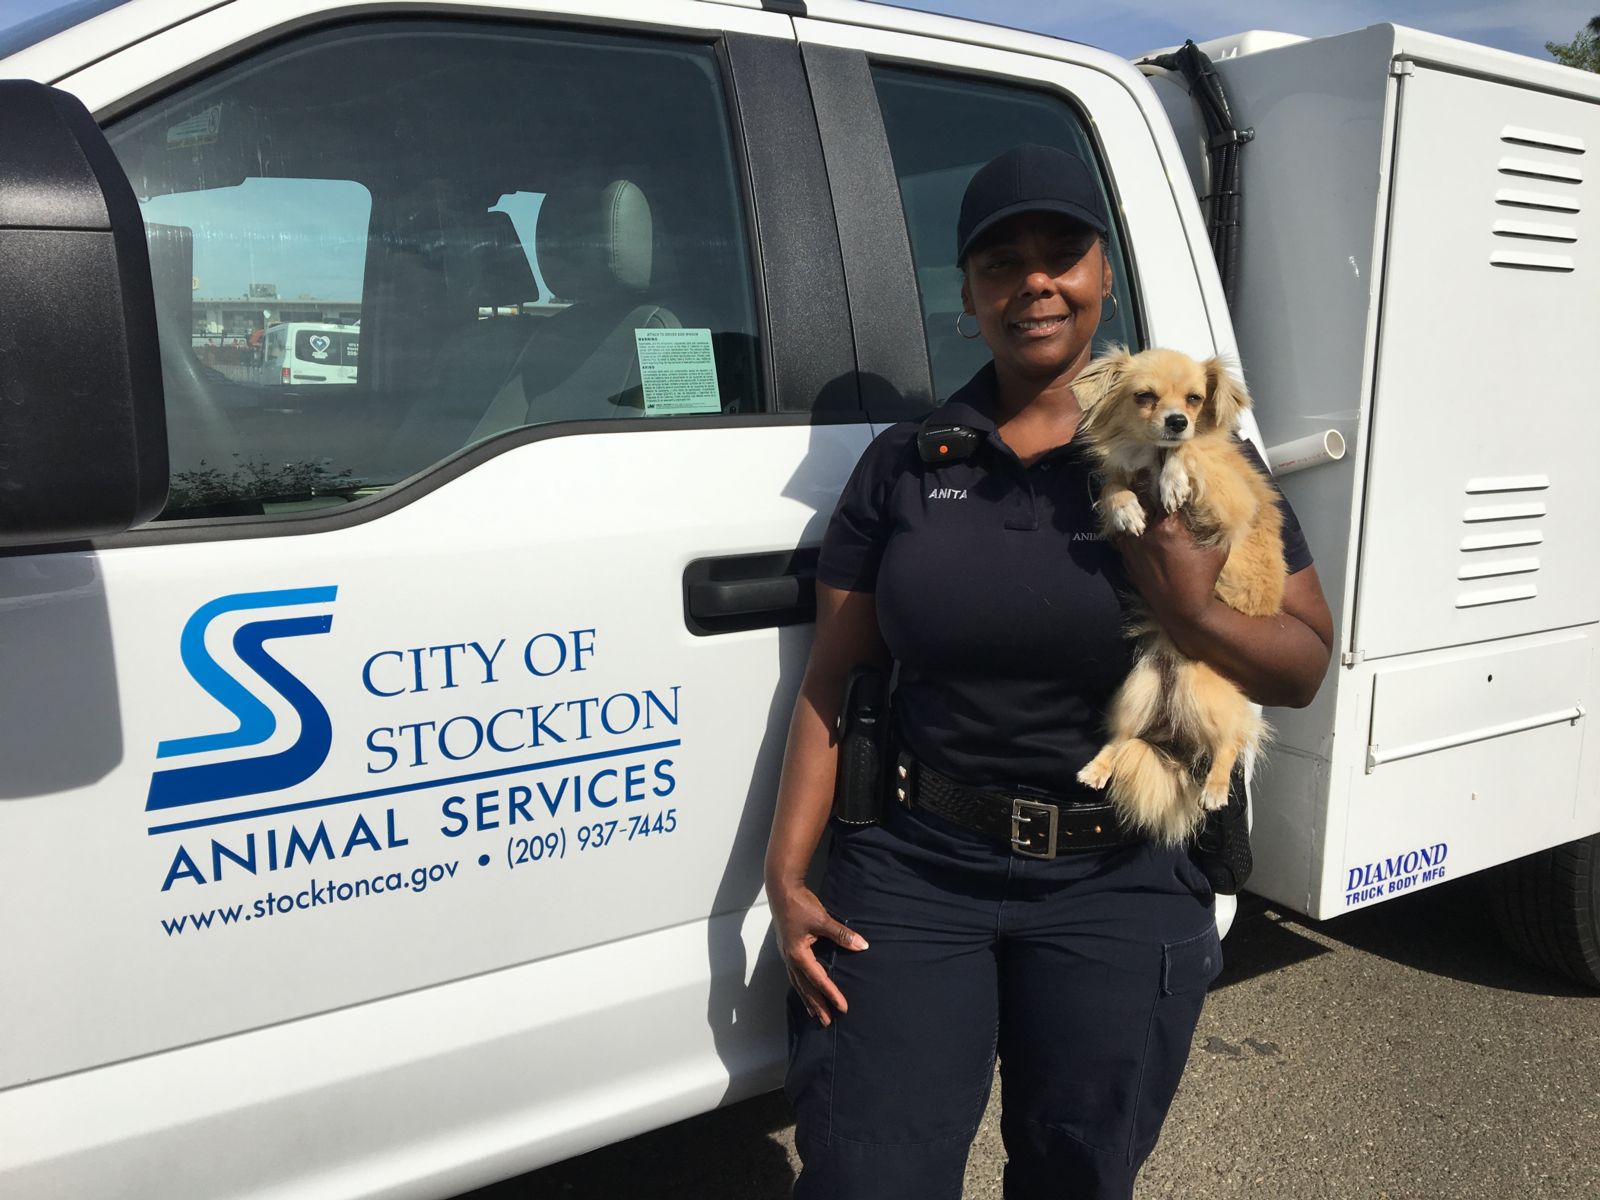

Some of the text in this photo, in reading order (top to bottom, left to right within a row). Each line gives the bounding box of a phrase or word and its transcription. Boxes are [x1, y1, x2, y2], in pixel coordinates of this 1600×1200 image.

[928, 488, 968, 500] ANITA
[362, 628, 597, 698] CITY OF
[366, 685, 682, 774] STOCKTON
[160, 759, 677, 892] ANIMAL SERVICES
[160, 808, 678, 937] www.stocktonca.gov (209) 937-7445
[1345, 866, 1446, 906] TRUCK BODY MFG
[1346, 842, 1448, 892] DIAMOND
